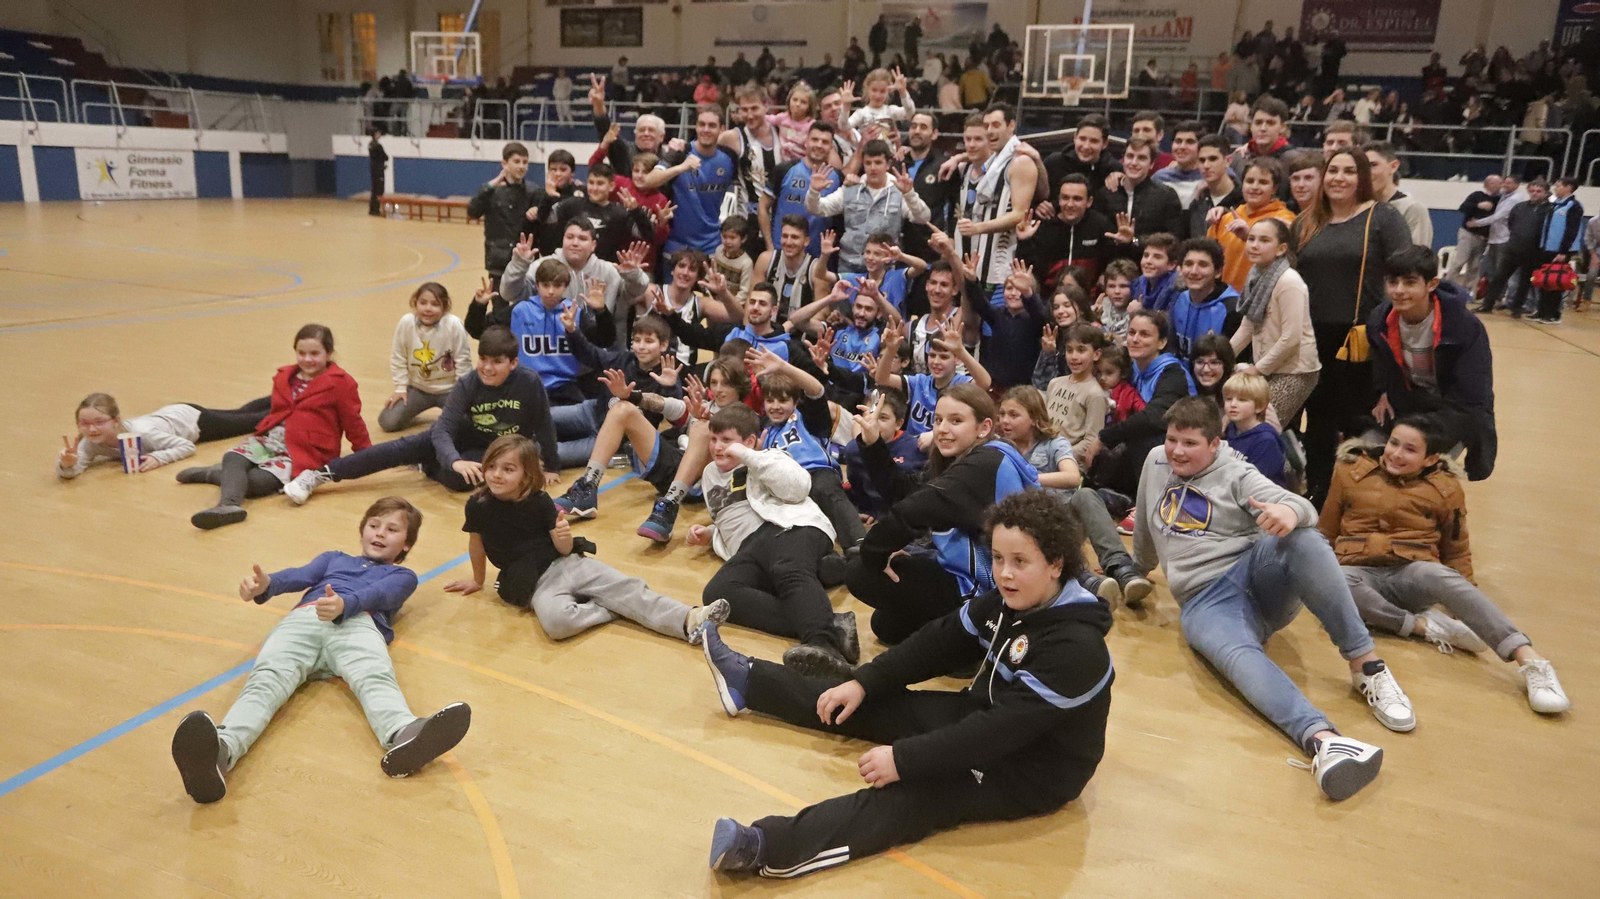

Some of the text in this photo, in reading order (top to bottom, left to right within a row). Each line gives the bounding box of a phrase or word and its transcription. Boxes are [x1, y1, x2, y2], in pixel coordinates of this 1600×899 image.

[127, 154, 183, 165] Gimnasio
[128, 166, 166, 177] Forma
[129, 178, 173, 189] Fitness
[791, 178, 806, 188] 20
[786, 194, 802, 204] LA
[842, 334, 848, 343] 6
[833, 347, 846, 359] LA
[1049, 401, 1070, 416] AYS
[911, 400, 935, 430] UL
